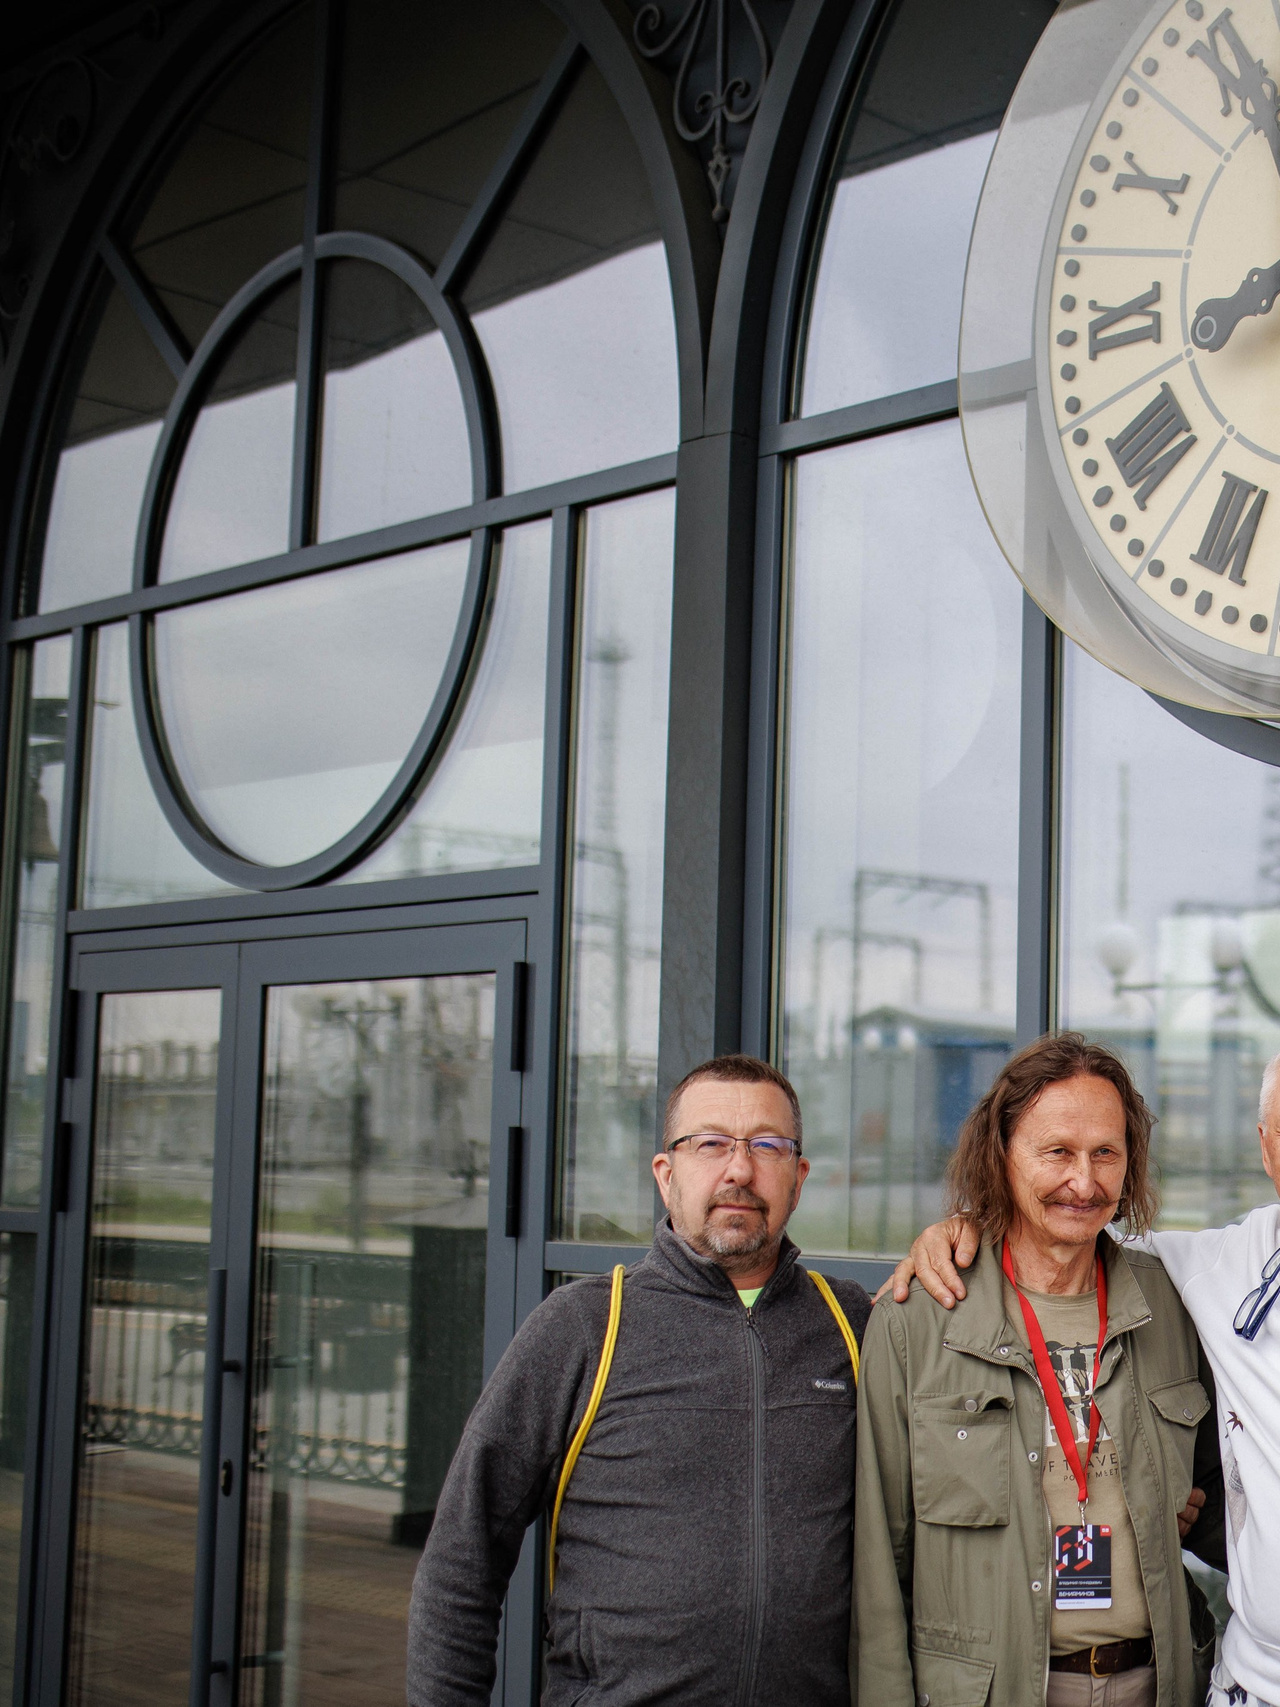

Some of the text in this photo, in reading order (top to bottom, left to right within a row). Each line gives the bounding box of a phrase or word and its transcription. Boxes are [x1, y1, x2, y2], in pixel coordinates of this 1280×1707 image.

[1112, 151, 1191, 215] X
[1087, 281, 1162, 361] IX
[1104, 381, 1199, 511] VIII
[1188, 470, 1269, 587] VII
[821, 1380, 846, 1390] Columbia
[1063, 1453, 1118, 1471] TAVE
[1064, 1472, 1091, 1481] POT
